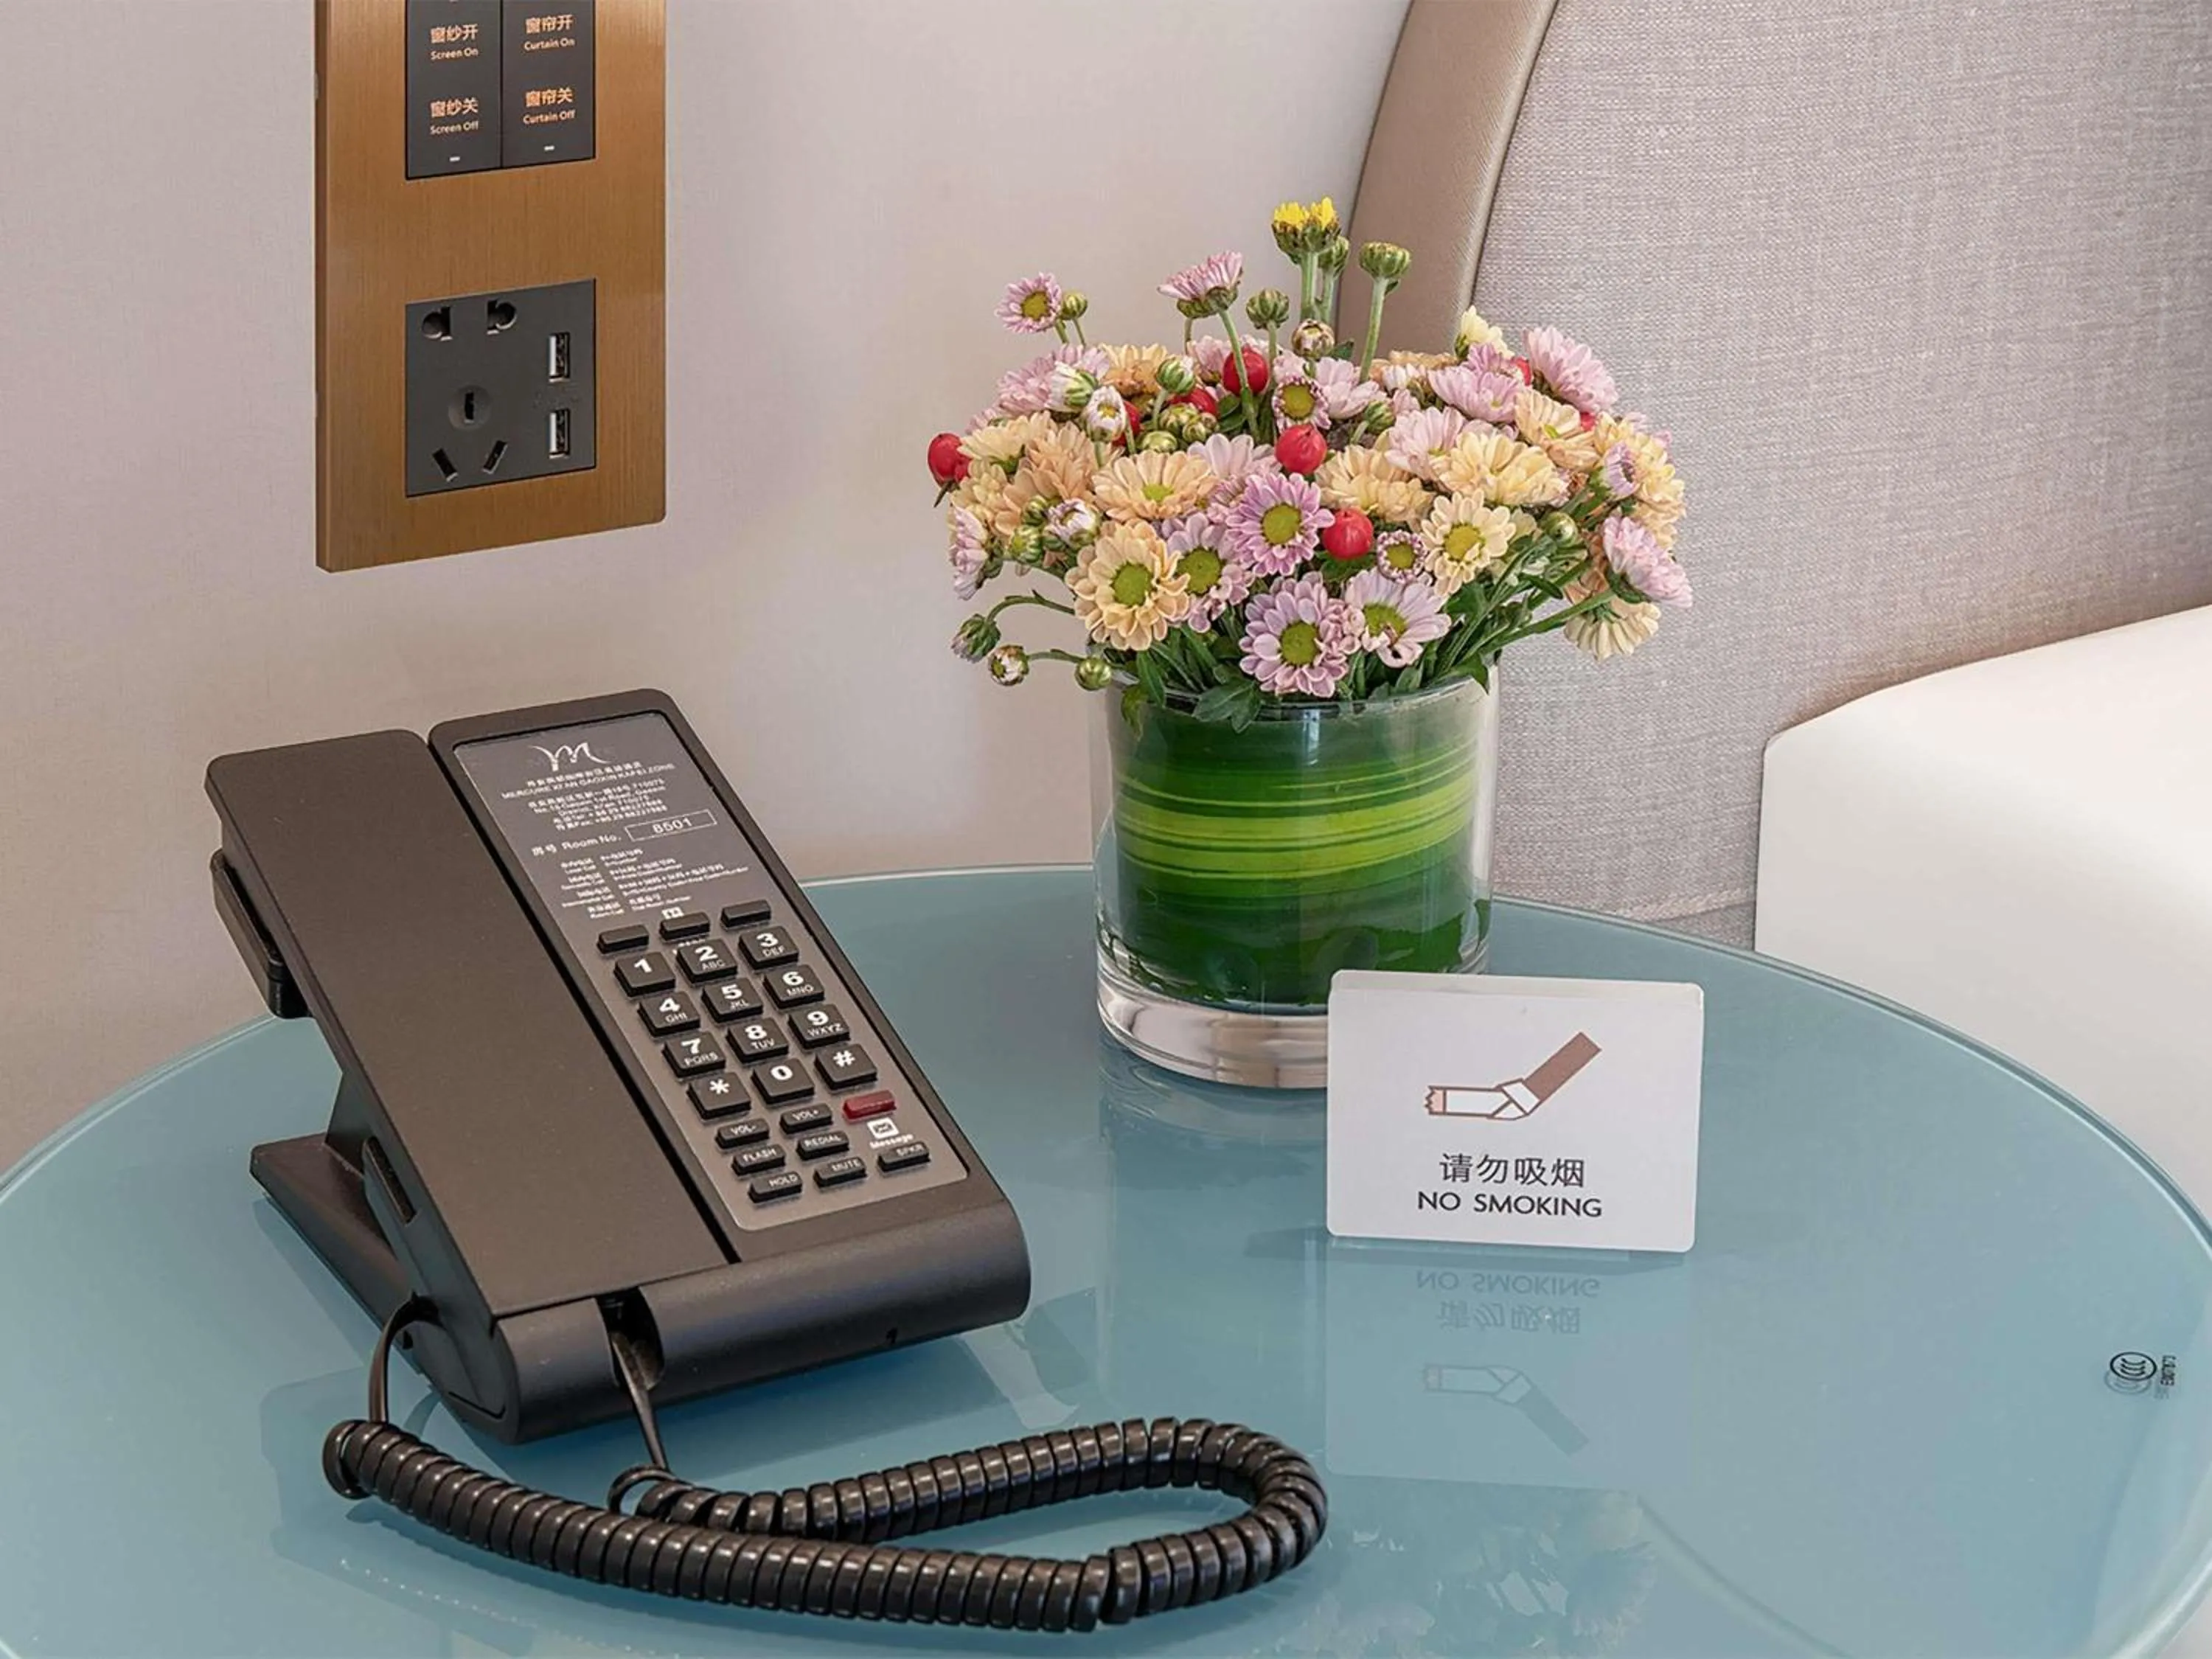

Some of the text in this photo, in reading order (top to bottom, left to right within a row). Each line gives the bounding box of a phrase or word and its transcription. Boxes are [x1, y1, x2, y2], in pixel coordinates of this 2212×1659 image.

[524, 38, 575, 51] Curtain On
[431, 47, 479, 60] Screen On
[523, 110, 576, 125] Curtain Off
[430, 120, 479, 135] Screen Off
[561, 837, 599, 851] Room
[756, 933, 779, 947] 3
[694, 945, 719, 962] 2
[762, 945, 785, 958] DEF
[633, 959, 653, 974] 1
[701, 959, 727, 971] ABC
[782, 971, 804, 987] 6
[720, 984, 743, 1000] 5
[658, 998, 681, 1013] 4
[666, 1011, 687, 1023] GHI
[807, 1011, 830, 1026] 9
[745, 1024, 768, 1040] 8
[681, 1038, 701, 1055] 7
[751, 1038, 775, 1051] TUV
[771, 1065, 793, 1081] 0
[804, 1135, 842, 1147] REDIAL
[742, 1148, 776, 1161] FLASH
[832, 1158, 861, 1172] MUTE
[1439, 1153, 1585, 1188] 请勿吸烟
[769, 1173, 798, 1186] HOLD
[1417, 1191, 1603, 1218] NO SMOKING
